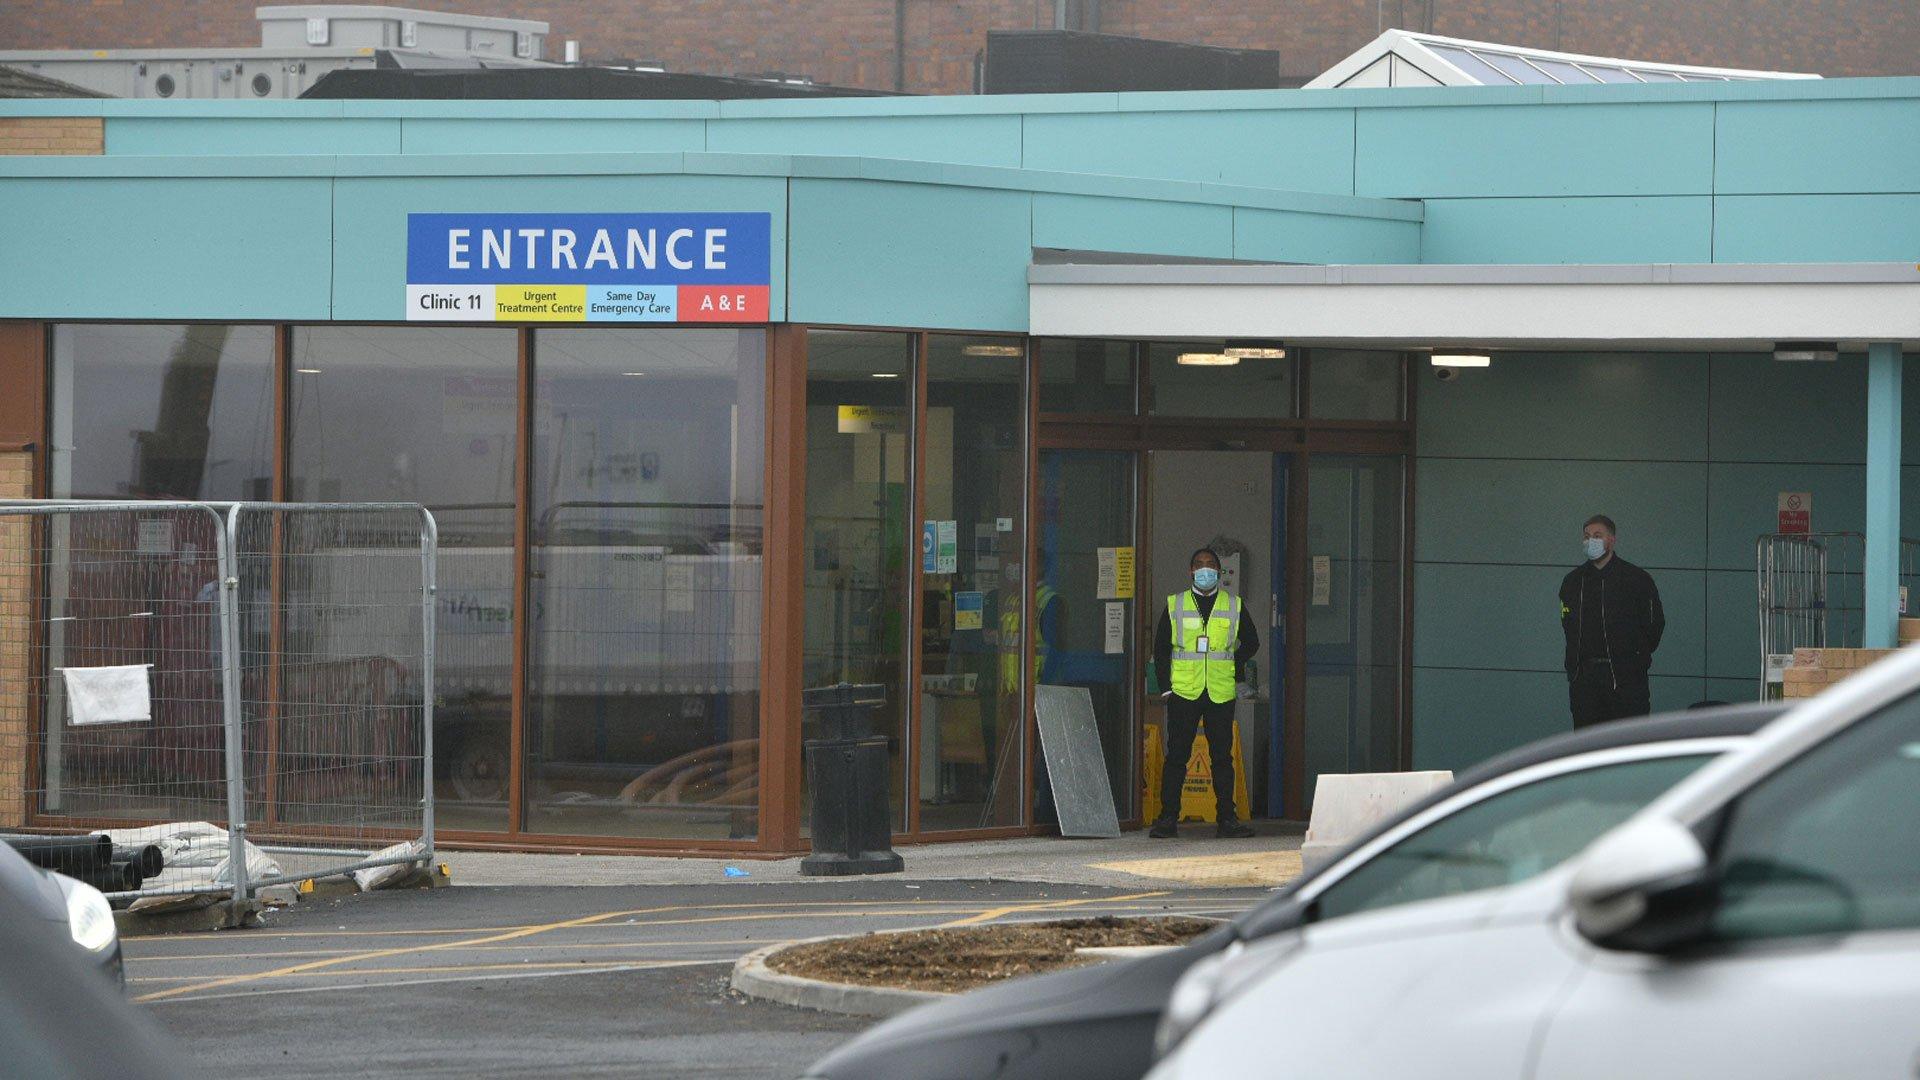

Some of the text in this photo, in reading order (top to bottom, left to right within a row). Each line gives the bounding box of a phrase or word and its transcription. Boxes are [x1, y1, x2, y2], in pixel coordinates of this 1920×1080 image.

[449, 228, 727, 269] ENTRANCE
[420, 294, 481, 310] Clinic 11
[524, 291, 557, 303] Urgent
[606, 291, 657, 303] Same Day
[700, 294, 746, 311] A & E
[498, 303, 583, 313] Treatment Centre
[591, 303, 671, 315] Emergency Care
